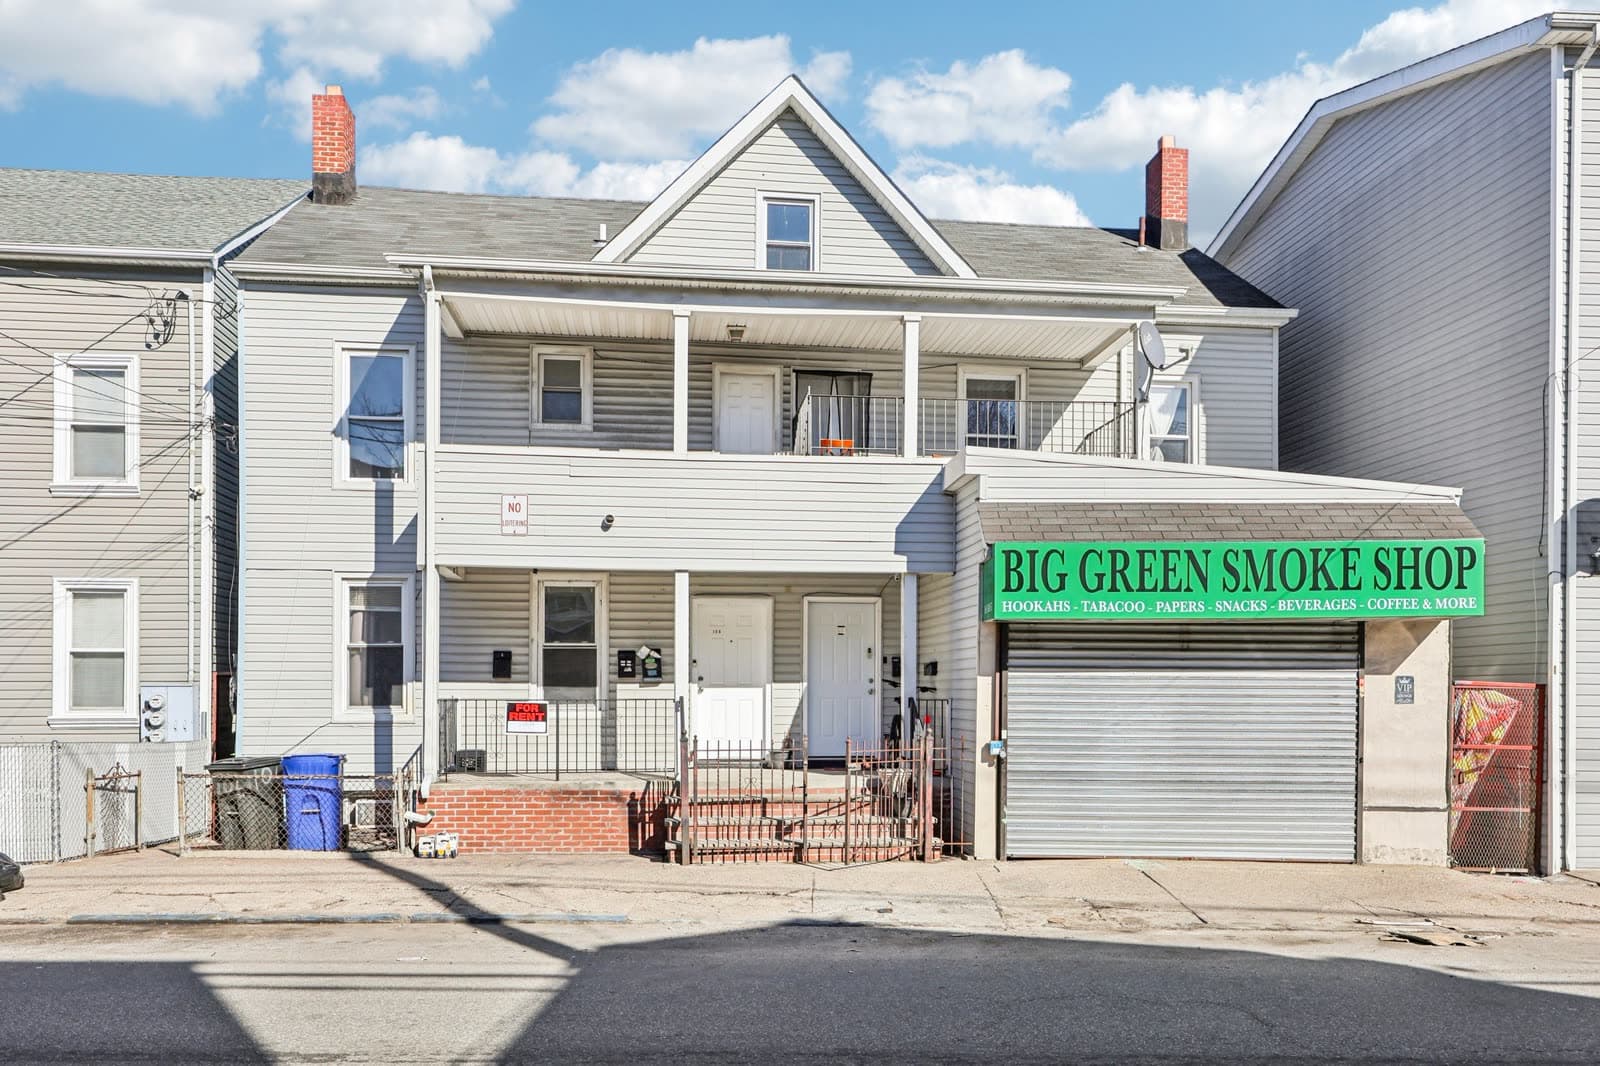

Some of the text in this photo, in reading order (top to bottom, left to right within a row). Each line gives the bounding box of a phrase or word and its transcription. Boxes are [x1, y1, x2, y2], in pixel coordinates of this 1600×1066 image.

[508, 502, 521, 512] NO
[1001, 546, 1477, 593] BIG GREEN SMOKE SHOP
[1002, 600, 1070, 612] HOOKAHS
[1081, 600, 1145, 613] TABACOO
[1156, 600, 1205, 613] PAPERS
[1215, 600, 1267, 612] SNACKS
[1277, 599, 1357, 611] BEVERAGES
[1367, 598, 1419, 610] COFFEE
[1422, 601, 1432, 609] &
[1435, 597, 1477, 609] MORE
[1397, 683, 1412, 692] VIP
[515, 703, 539, 712] FOR
[509, 711, 545, 721] RENT
